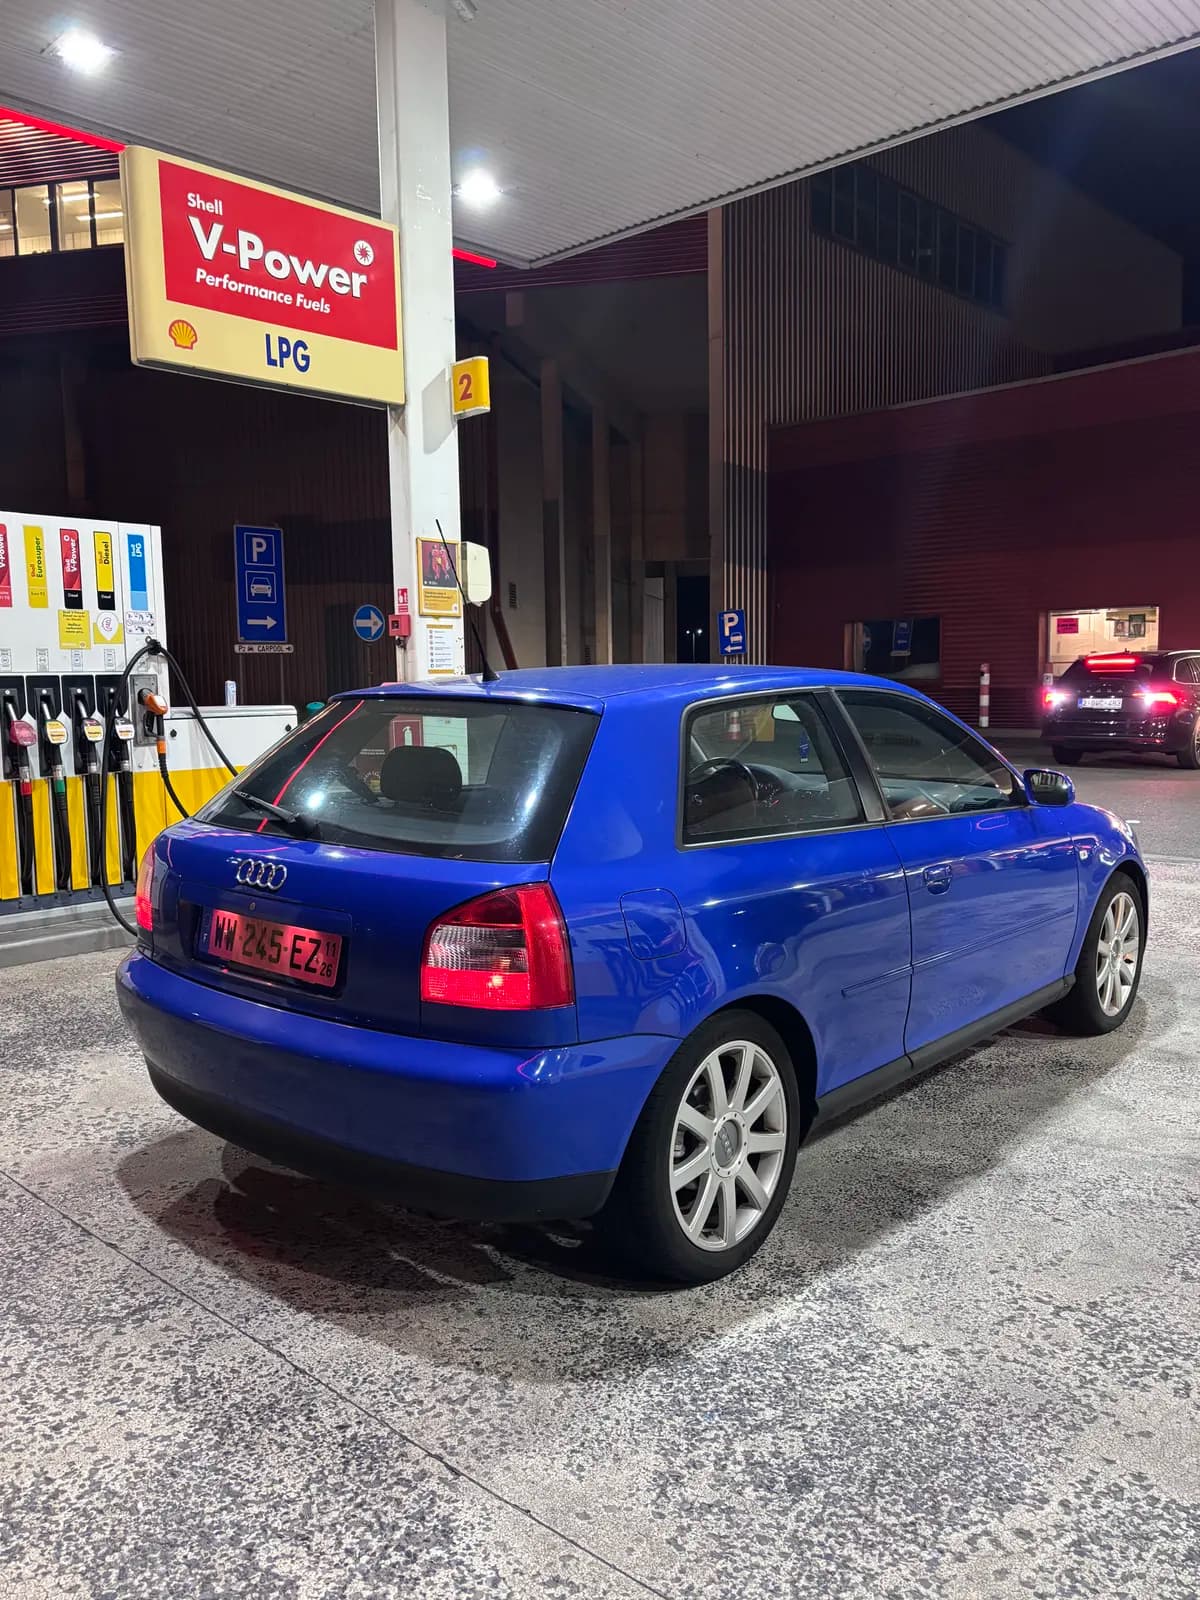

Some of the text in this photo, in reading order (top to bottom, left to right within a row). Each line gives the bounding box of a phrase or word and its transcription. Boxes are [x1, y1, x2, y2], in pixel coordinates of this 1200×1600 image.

[187, 192, 224, 216] Shell
[188, 214, 368, 299] V-Power
[195, 267, 331, 315] Performance Fuels
[265, 333, 311, 373] LPG
[458, 373, 473, 401] 2
[35, 536, 43, 578] Eurosuper
[102, 541, 110, 565] Diesel
[135, 542, 143, 558] LPG
[252, 537, 267, 562] P
[723, 613, 739, 637] P
[325, 941, 337, 957] 11
[319, 962, 333, 978] 26
